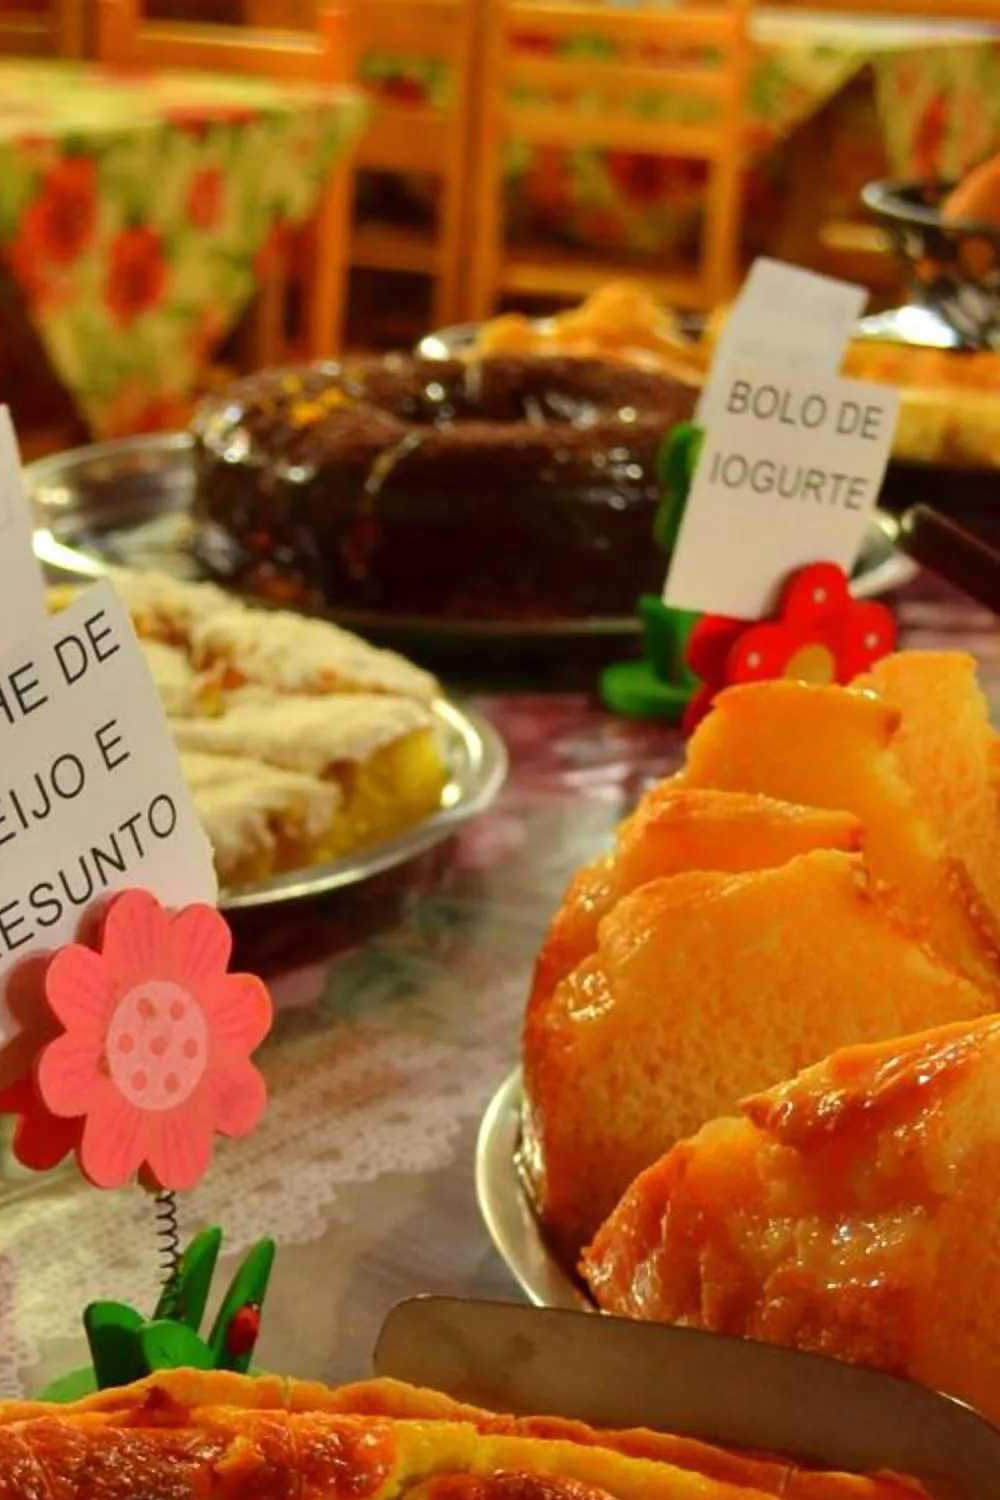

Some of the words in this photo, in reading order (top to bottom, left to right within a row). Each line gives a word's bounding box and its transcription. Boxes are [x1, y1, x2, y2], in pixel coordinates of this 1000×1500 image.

[726, 379, 828, 430] BOLO
[836, 401, 884, 441] DE
[708, 452, 871, 511] IOGURTE
[54, 610, 121, 685] DE
[94, 719, 132, 771] E
